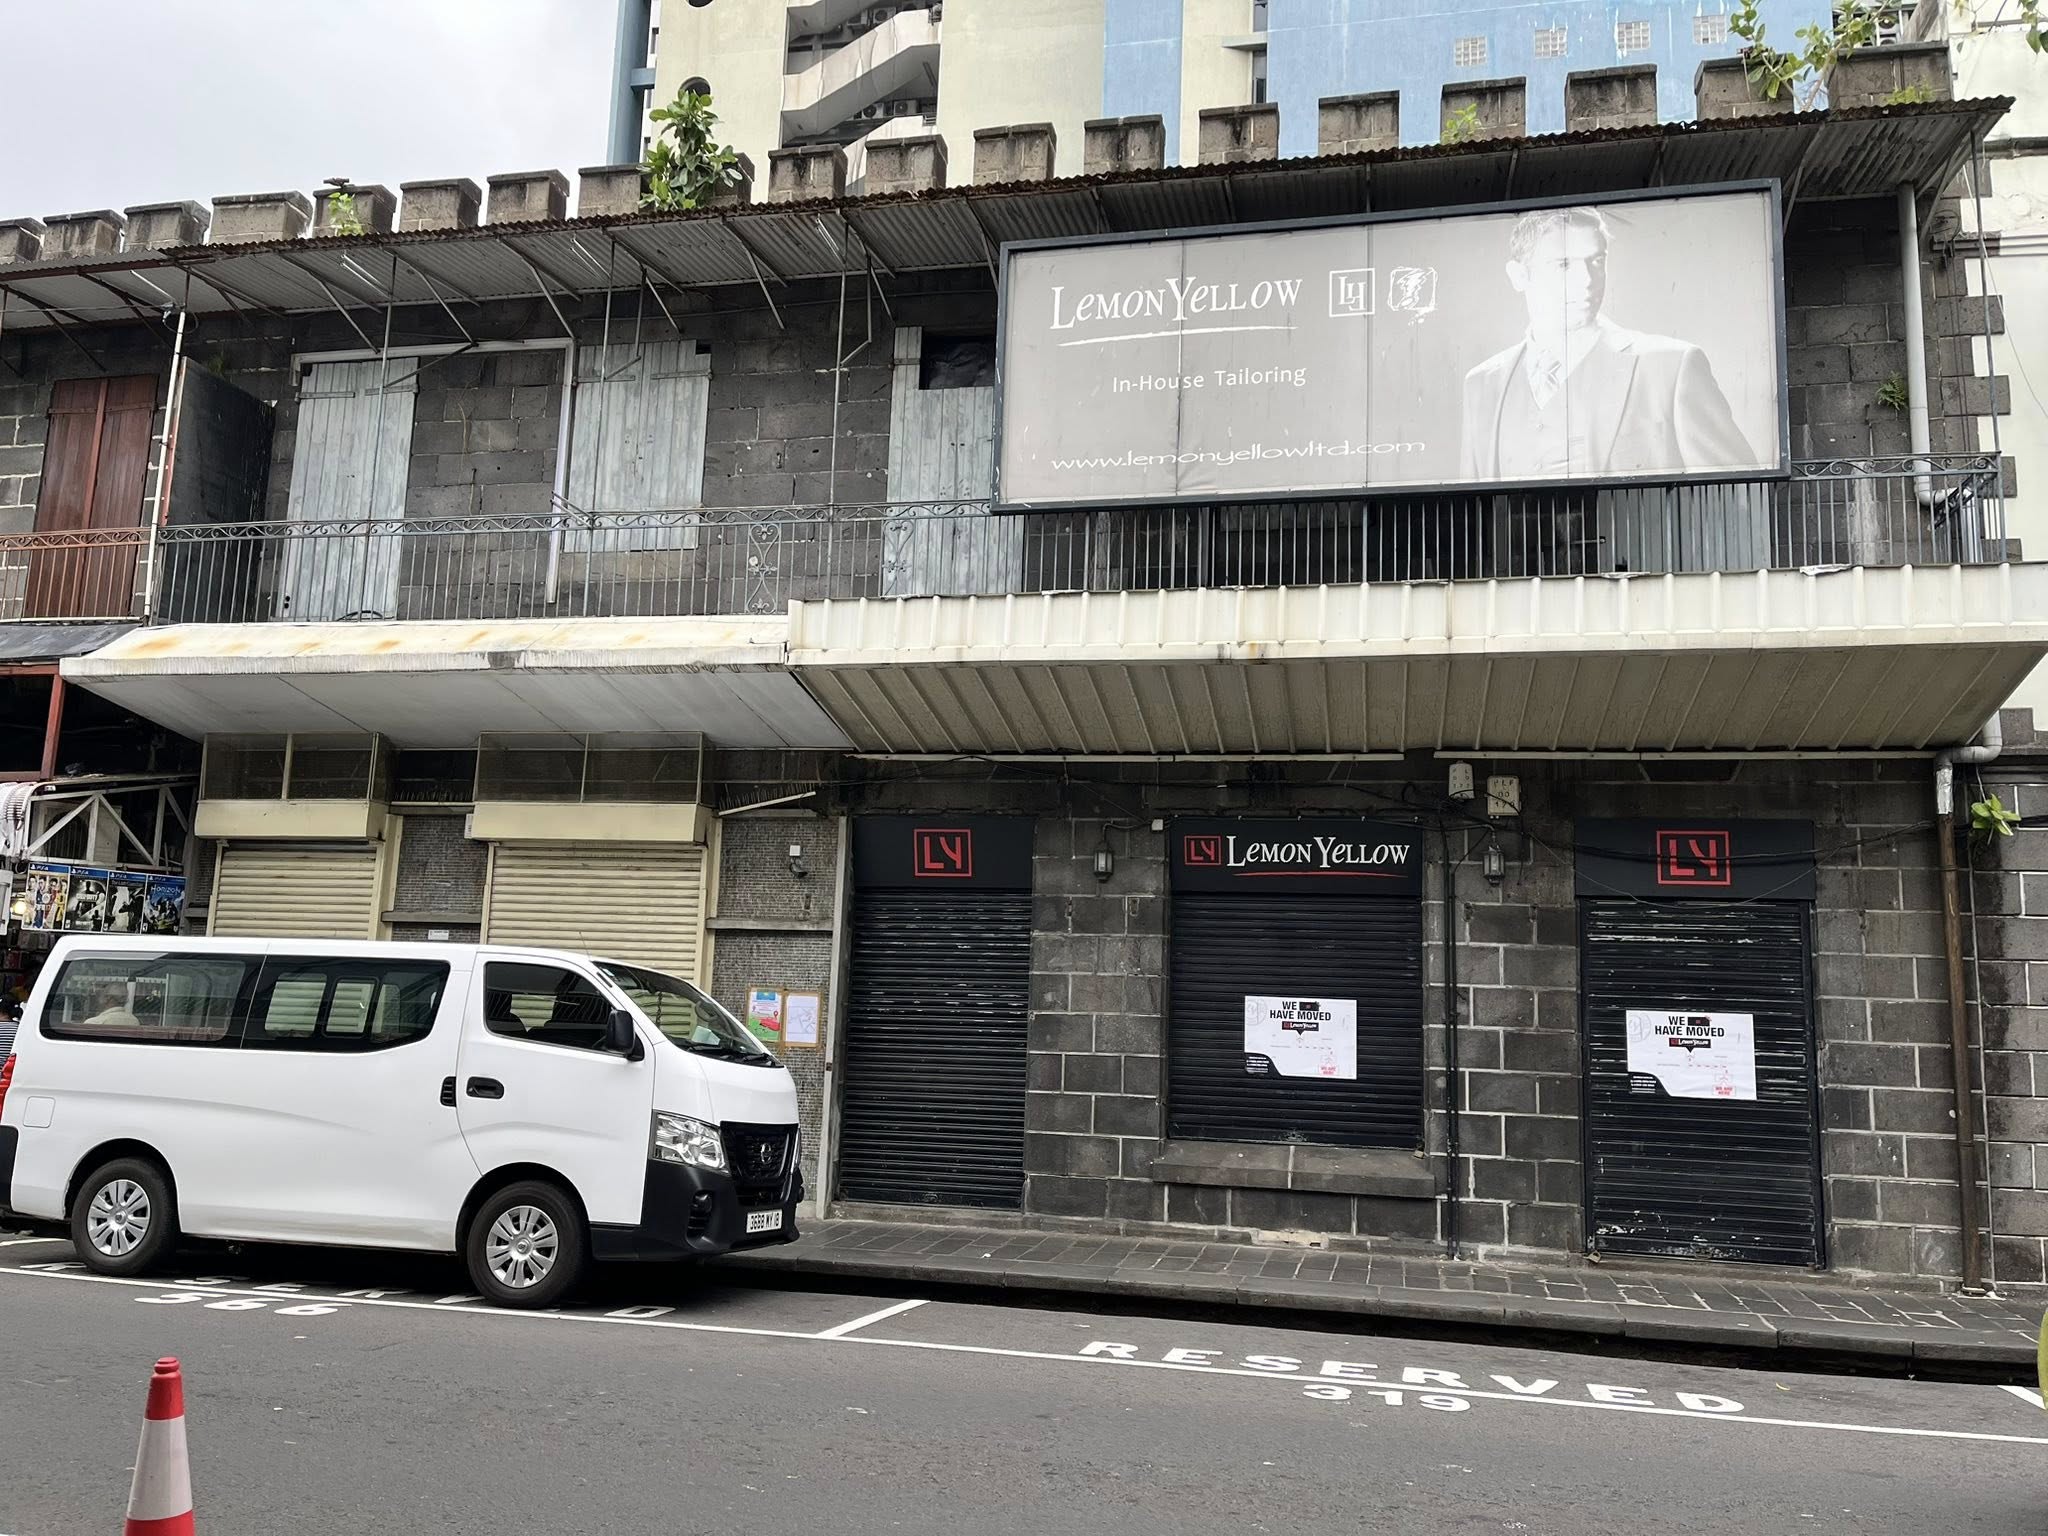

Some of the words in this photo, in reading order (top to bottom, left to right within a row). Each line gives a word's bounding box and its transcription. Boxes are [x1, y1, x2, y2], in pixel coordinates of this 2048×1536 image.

[1113, 373, 1204, 393] In-House
[1214, 366, 1308, 386] Tailoring
[1052, 439, 1426, 470] www.lemonyellowltd.com
[1269, 1010, 1295, 1020] HAVE
[1297, 1011, 1332, 1021] MOVED
[1282, 1001, 1298, 1011] WE
[1655, 1026, 1683, 1036] HAVE
[1686, 1027, 1725, 1038] MOVED
[1668, 1016, 1686, 1026] WE
[134, 1292, 352, 1316] 566
[1077, 1340, 1746, 1415] RESERVED
[1302, 1383, 1472, 1413] 319
